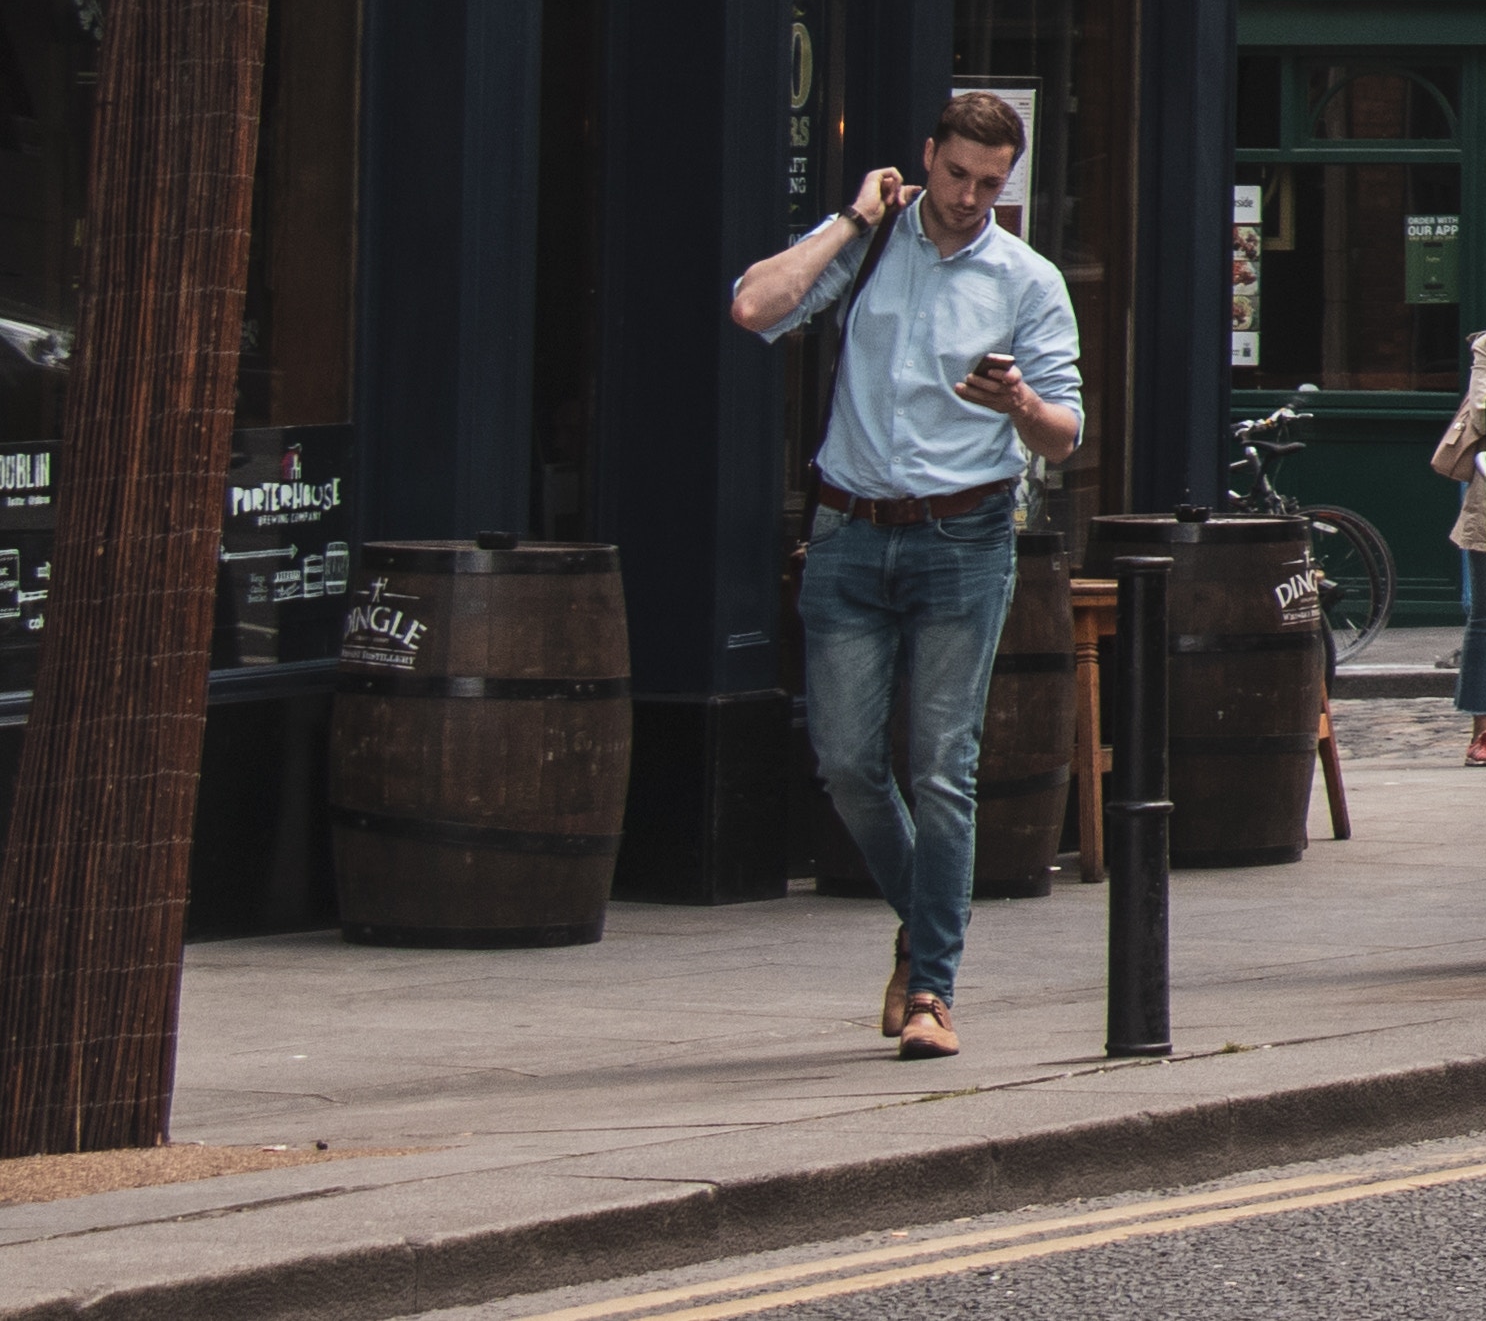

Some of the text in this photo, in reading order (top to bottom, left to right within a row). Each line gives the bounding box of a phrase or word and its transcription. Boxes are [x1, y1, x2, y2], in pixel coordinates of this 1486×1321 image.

[1407, 216, 1459, 225] ORDER WITH
[1407, 224, 1460, 236] OUR APP
[231, 477, 343, 516] PORTERHOUSE
